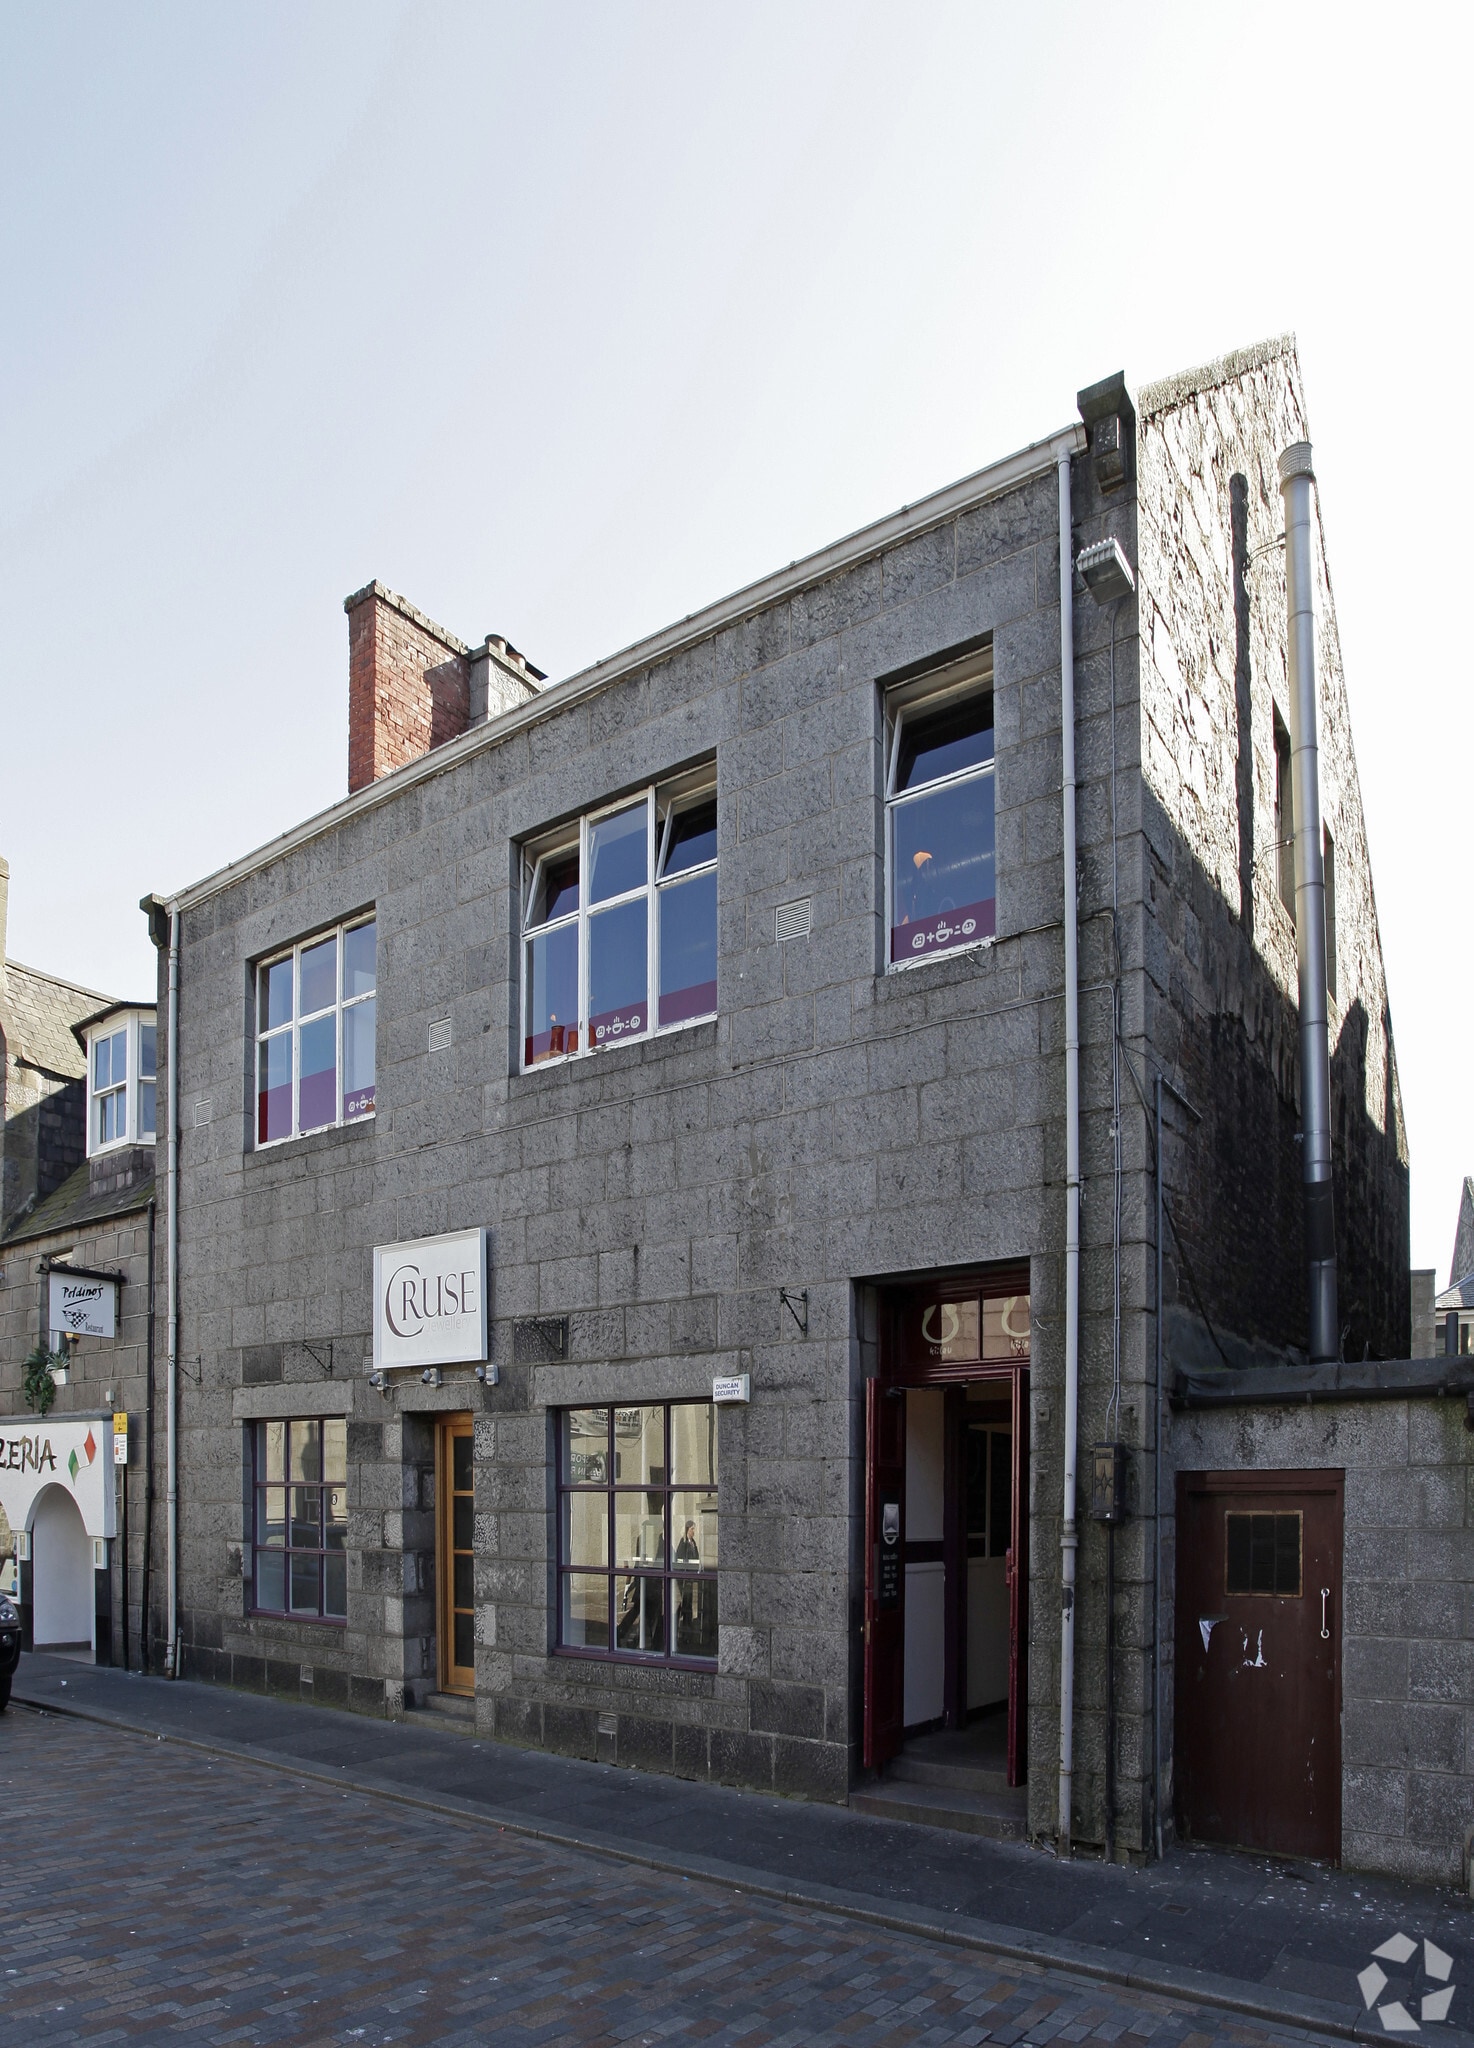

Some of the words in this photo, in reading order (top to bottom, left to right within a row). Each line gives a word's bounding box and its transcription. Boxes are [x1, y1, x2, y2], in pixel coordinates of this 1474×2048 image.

[385, 1265, 476, 1337] CRUSE
[716, 1382, 739, 1390] DUNCAN
[714, 1389, 740, 1397] SECURITY
